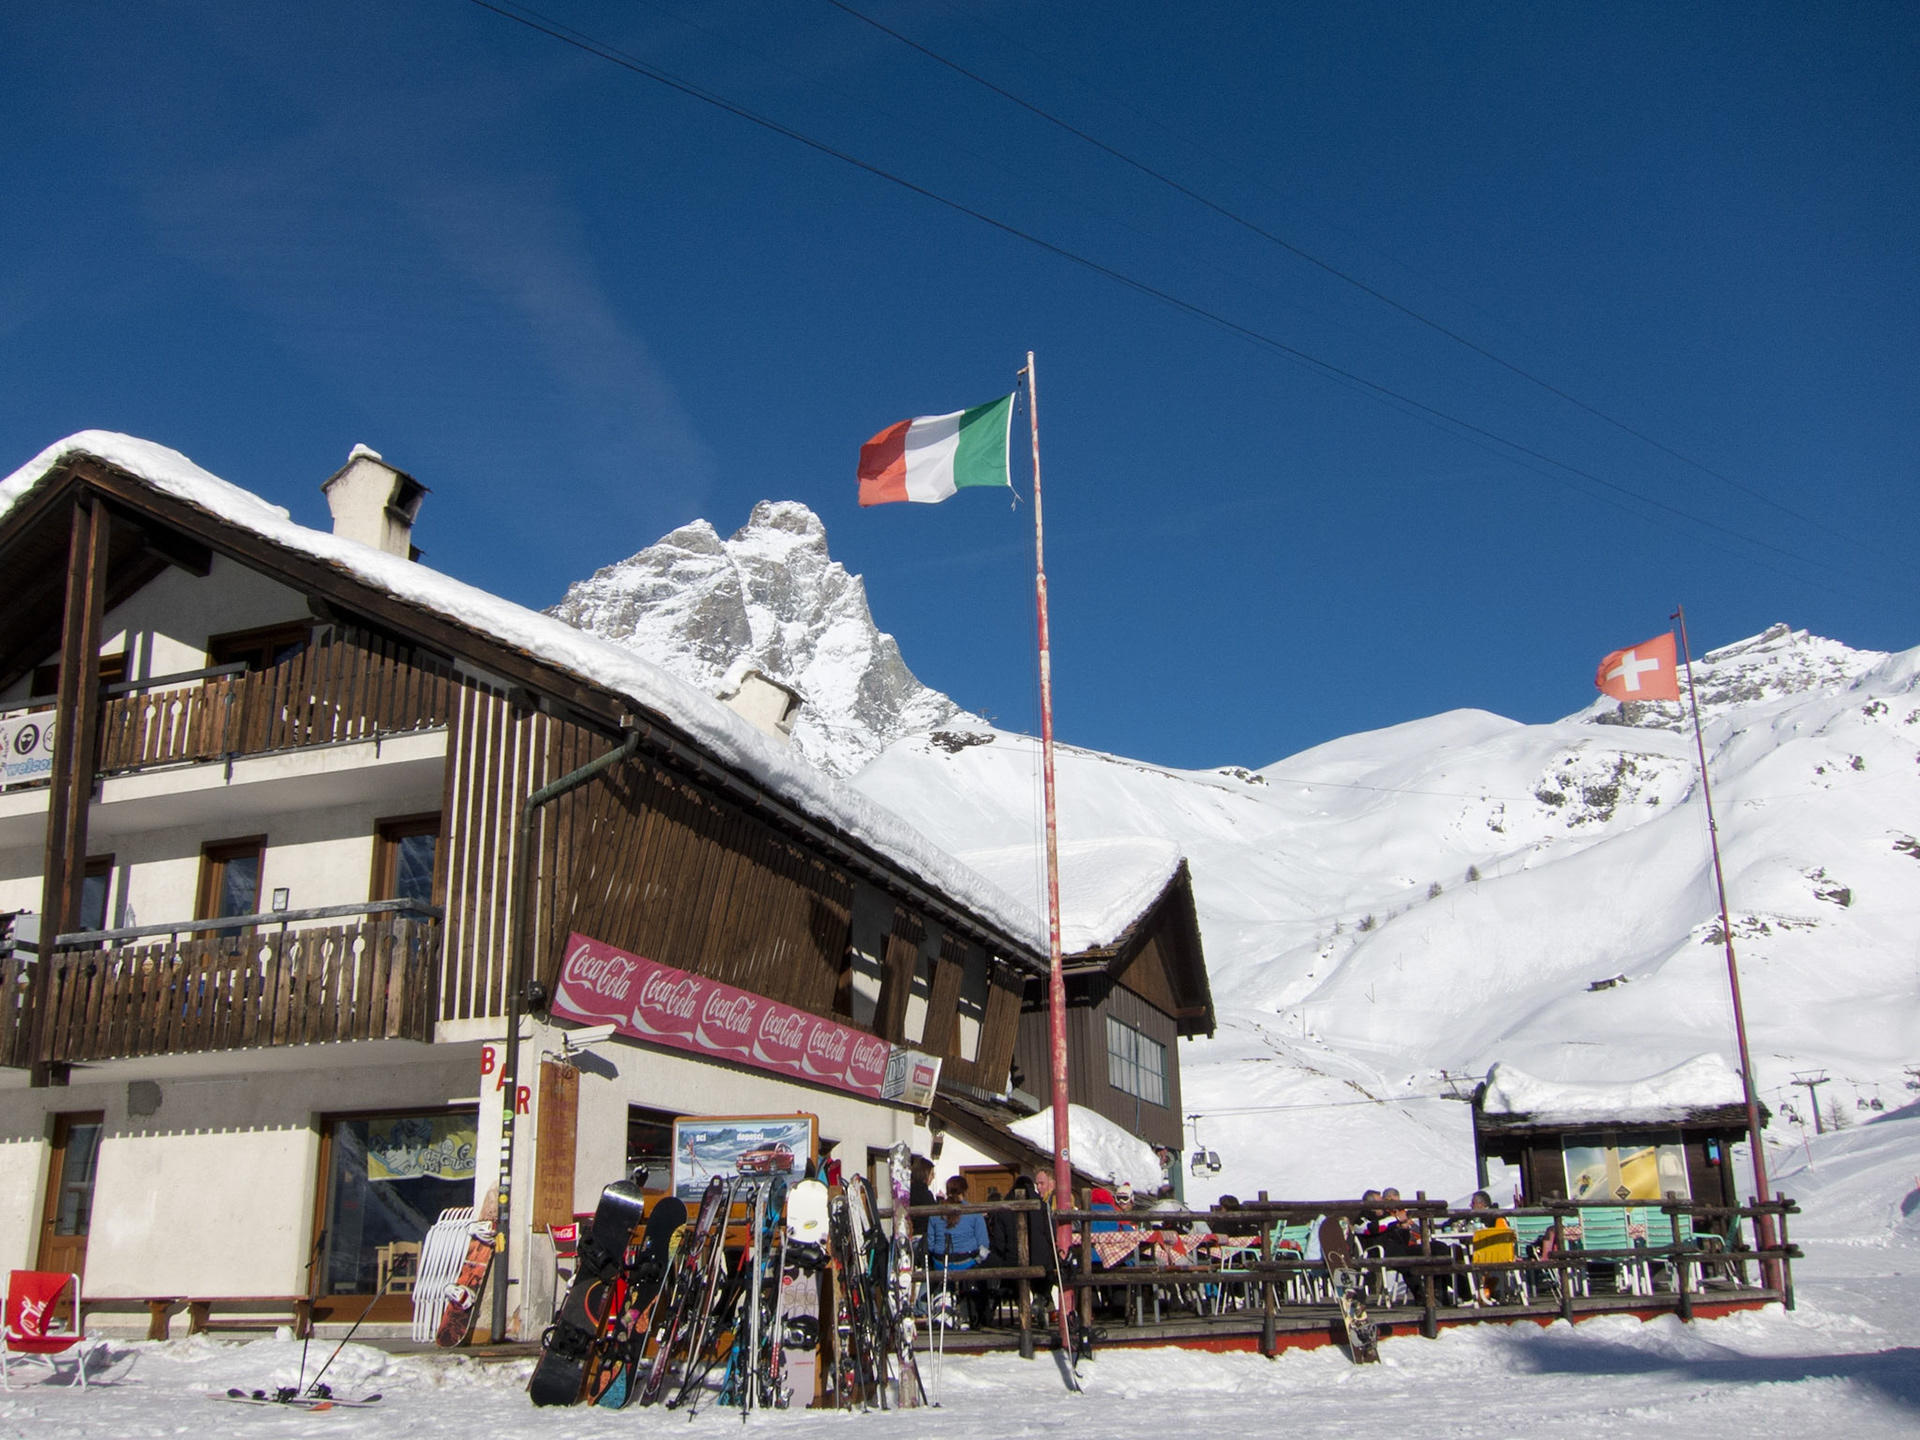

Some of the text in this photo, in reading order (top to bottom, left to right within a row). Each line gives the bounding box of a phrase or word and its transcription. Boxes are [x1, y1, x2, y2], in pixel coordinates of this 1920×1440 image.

[565, 943, 638, 1000] Coca-Cola
[640, 970, 702, 1019] Coca-Cola
[702, 988, 757, 1034] Coca-Cola
[758, 1006, 808, 1049] Coca-Cola
[807, 1022, 849, 1062] Coca-Cola
[851, 1036, 887, 1074] Coca-Cola
